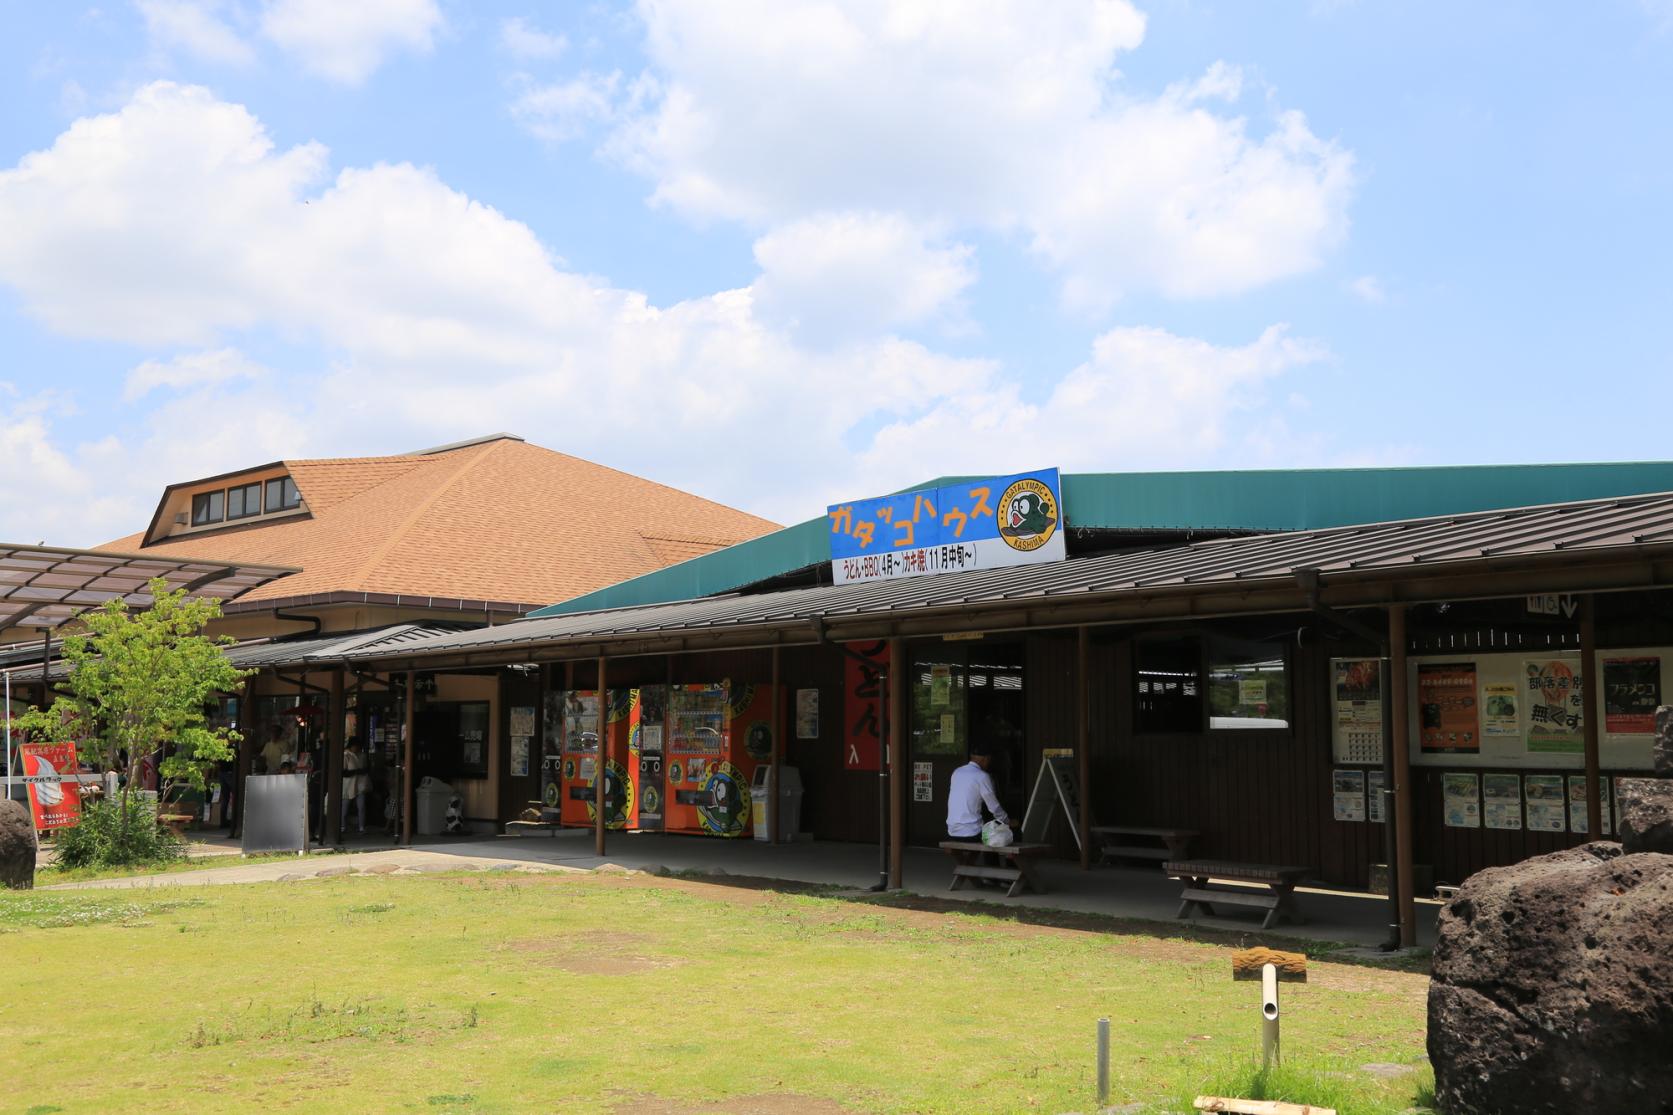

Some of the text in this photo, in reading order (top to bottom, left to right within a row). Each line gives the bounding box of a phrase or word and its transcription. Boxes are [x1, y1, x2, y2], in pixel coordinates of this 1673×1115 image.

[1006, 481, 1046, 499] GATALYMPIC
[829, 486, 994, 549] ガタッコハウス
[1013, 535, 1044, 550] KASHIMA
